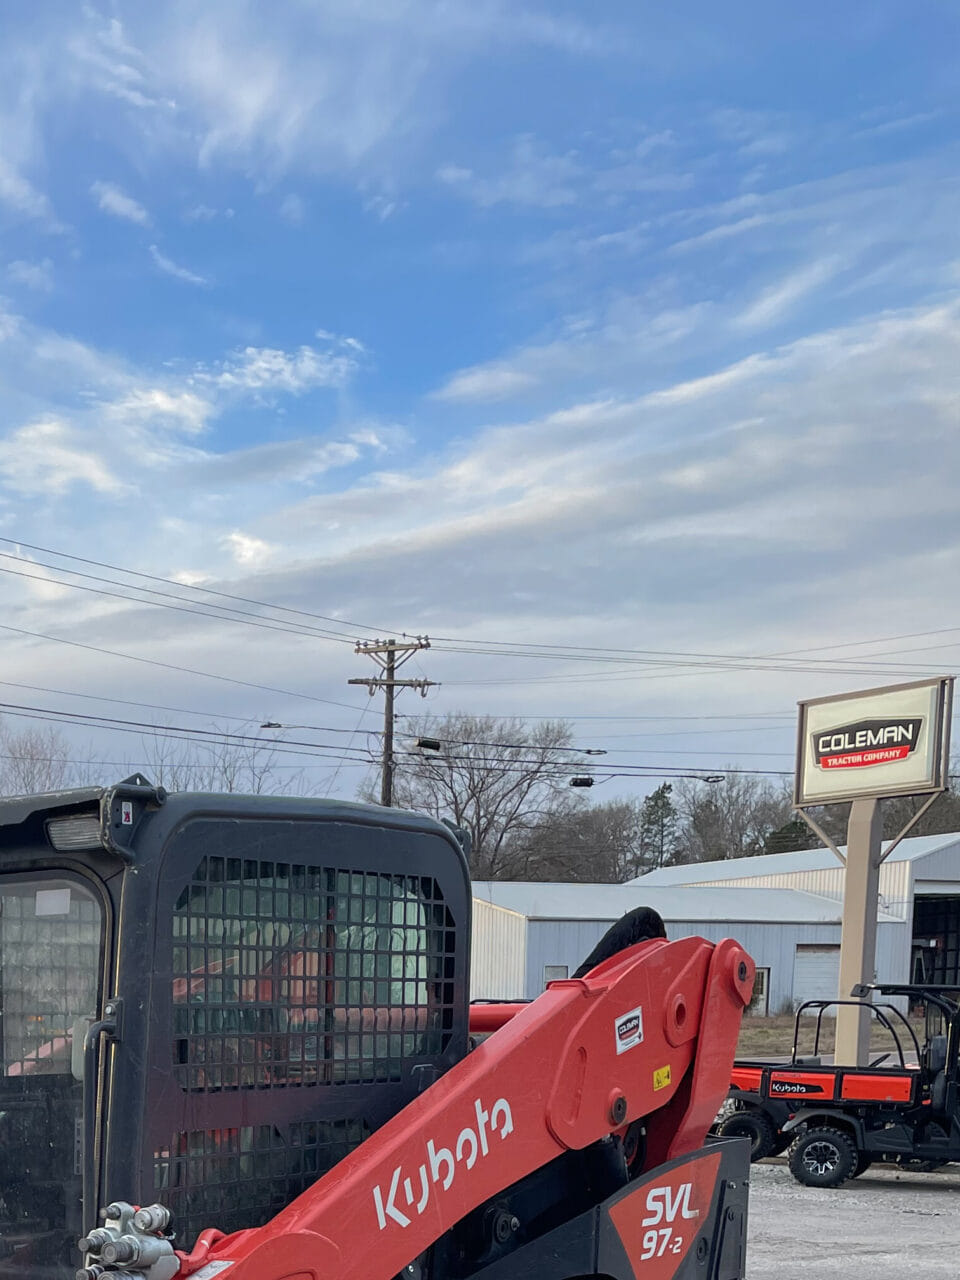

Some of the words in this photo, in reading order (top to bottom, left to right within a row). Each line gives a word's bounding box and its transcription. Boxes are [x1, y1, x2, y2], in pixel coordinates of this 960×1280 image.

[818, 723, 914, 753] COLEMAN
[827, 755, 862, 767] TRACTOR
[863, 749, 902, 762] COMPANY
[772, 1083, 807, 1093] Kubota
[372, 1098, 514, 1231] Kubota
[641, 1182, 699, 1227] SVL
